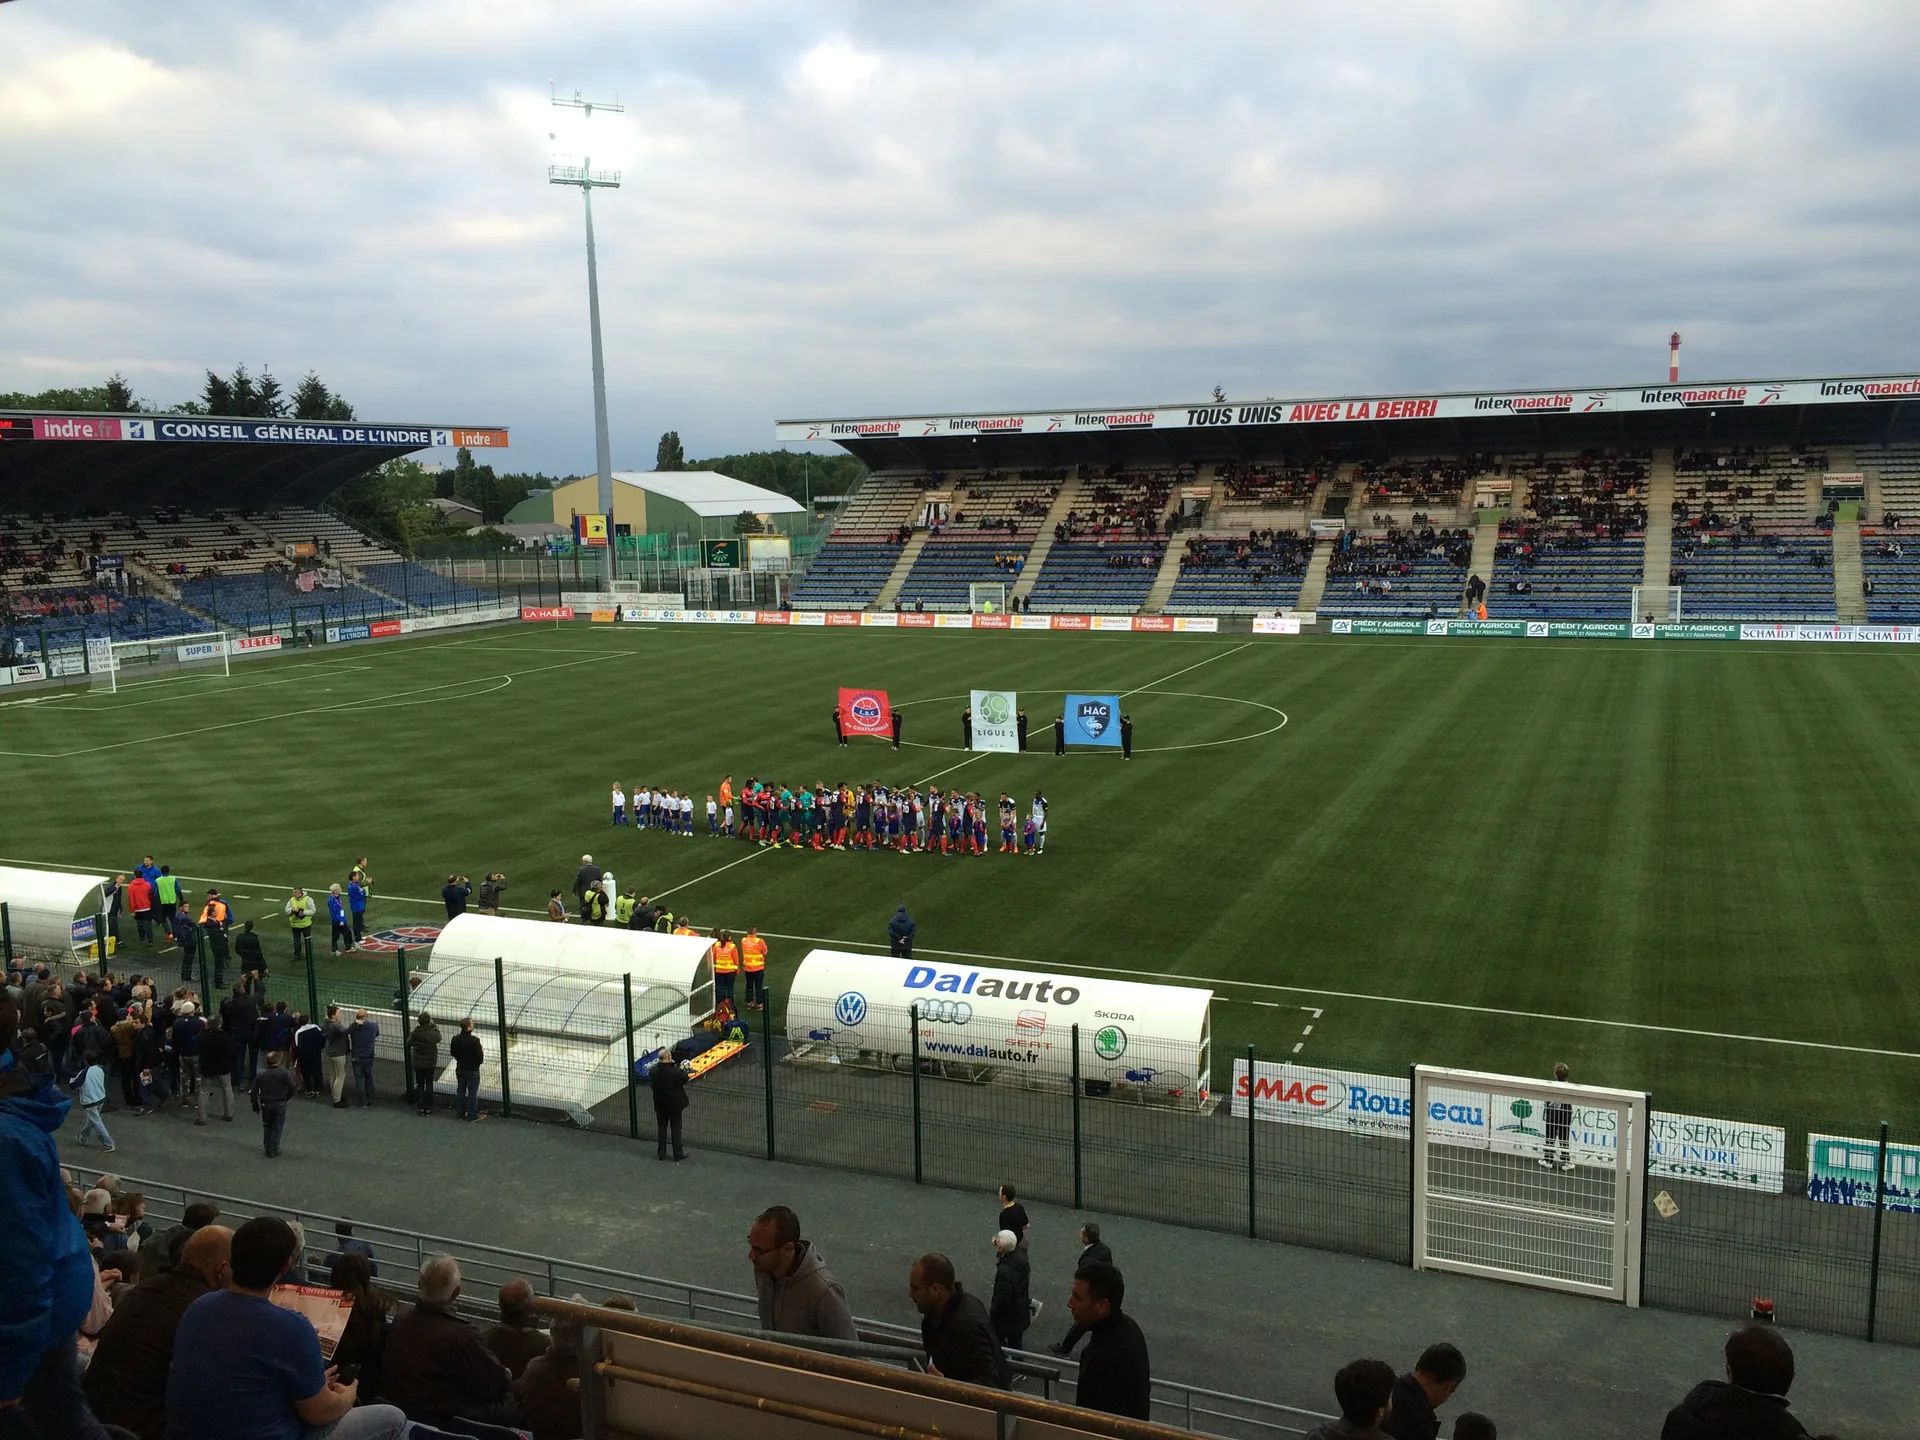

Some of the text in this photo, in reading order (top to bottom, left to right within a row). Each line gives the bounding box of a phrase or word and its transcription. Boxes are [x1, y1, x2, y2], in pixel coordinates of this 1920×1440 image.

[1474, 394, 1573, 412] Intermarché
[1641, 387, 1747, 405] Intermarché
[1075, 412, 1155, 427] Intermarché
[1187, 400, 1438, 425] TOUS UNIS AVEC LA BERRI
[44, 419, 113, 438] indre.fr
[831, 421, 901, 436] Intermarché
[949, 417, 1024, 432] Intermarché
[162, 423, 428, 443] CONSEIL GÉNÉRAL DE L'INDRE
[1550, 622, 1582, 630] CRÉDIT
[1693, 624, 1735, 632] AGRICOLE
[244, 636, 278, 648] SETEC
[186, 646, 212, 656] SUPER
[19, 666, 39, 675] David
[1083, 706, 1107, 716] HAC
[1010, 730, 1014, 738] 2
[903, 966, 1080, 1006] Dalauto
[1094, 1010, 1135, 1022] ŠKODA
[908, 1027, 934, 1038] udi
[925, 1040, 1039, 1063] www.dalauto.fr
[1005, 1038, 1053, 1050] SEAT
[1235, 1075, 1328, 1106] SMAC
[1348, 1086, 1484, 1126] Rouseau
[1683, 1122, 1773, 1152] SERVICES
[301, 1286, 344, 1297] L'INTERVIEW
